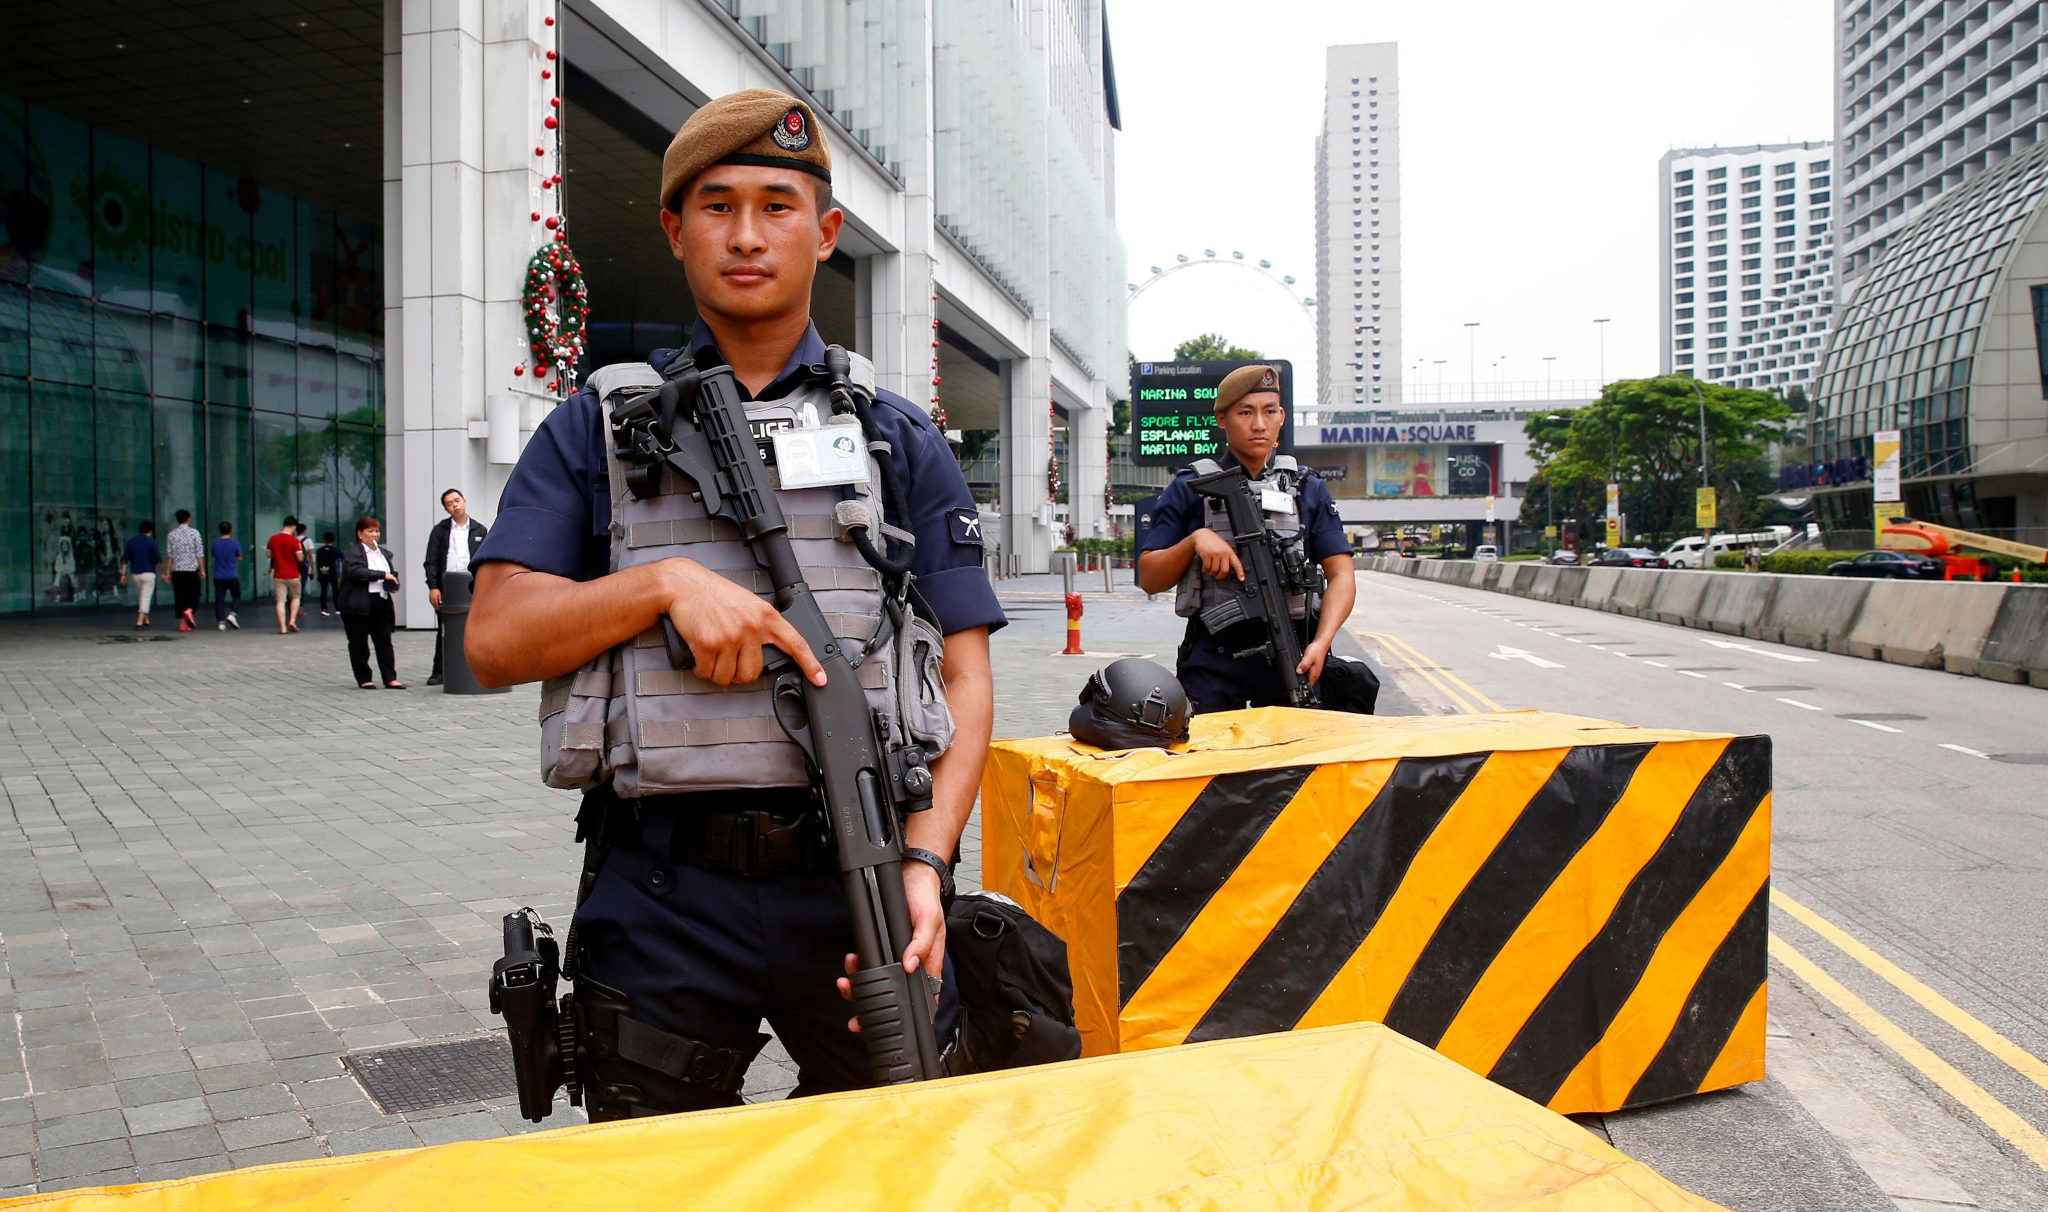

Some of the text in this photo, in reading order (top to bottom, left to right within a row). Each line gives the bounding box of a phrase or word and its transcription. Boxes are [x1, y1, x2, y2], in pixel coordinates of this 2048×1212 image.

[1154, 364, 1202, 376] Parking Location
[1140, 387, 1218, 400] MARINA SQU
[1140, 415, 1218, 427] SPORE FLYE
[749, 421, 790, 439] LICE
[1140, 429, 1211, 441] ESPLANADE
[1321, 425, 1476, 443] MARINA SQUARE
[1140, 443, 1188, 455] MARINA
[1194, 443, 1218, 454] BAY
[1458, 467, 1476, 477] CO
